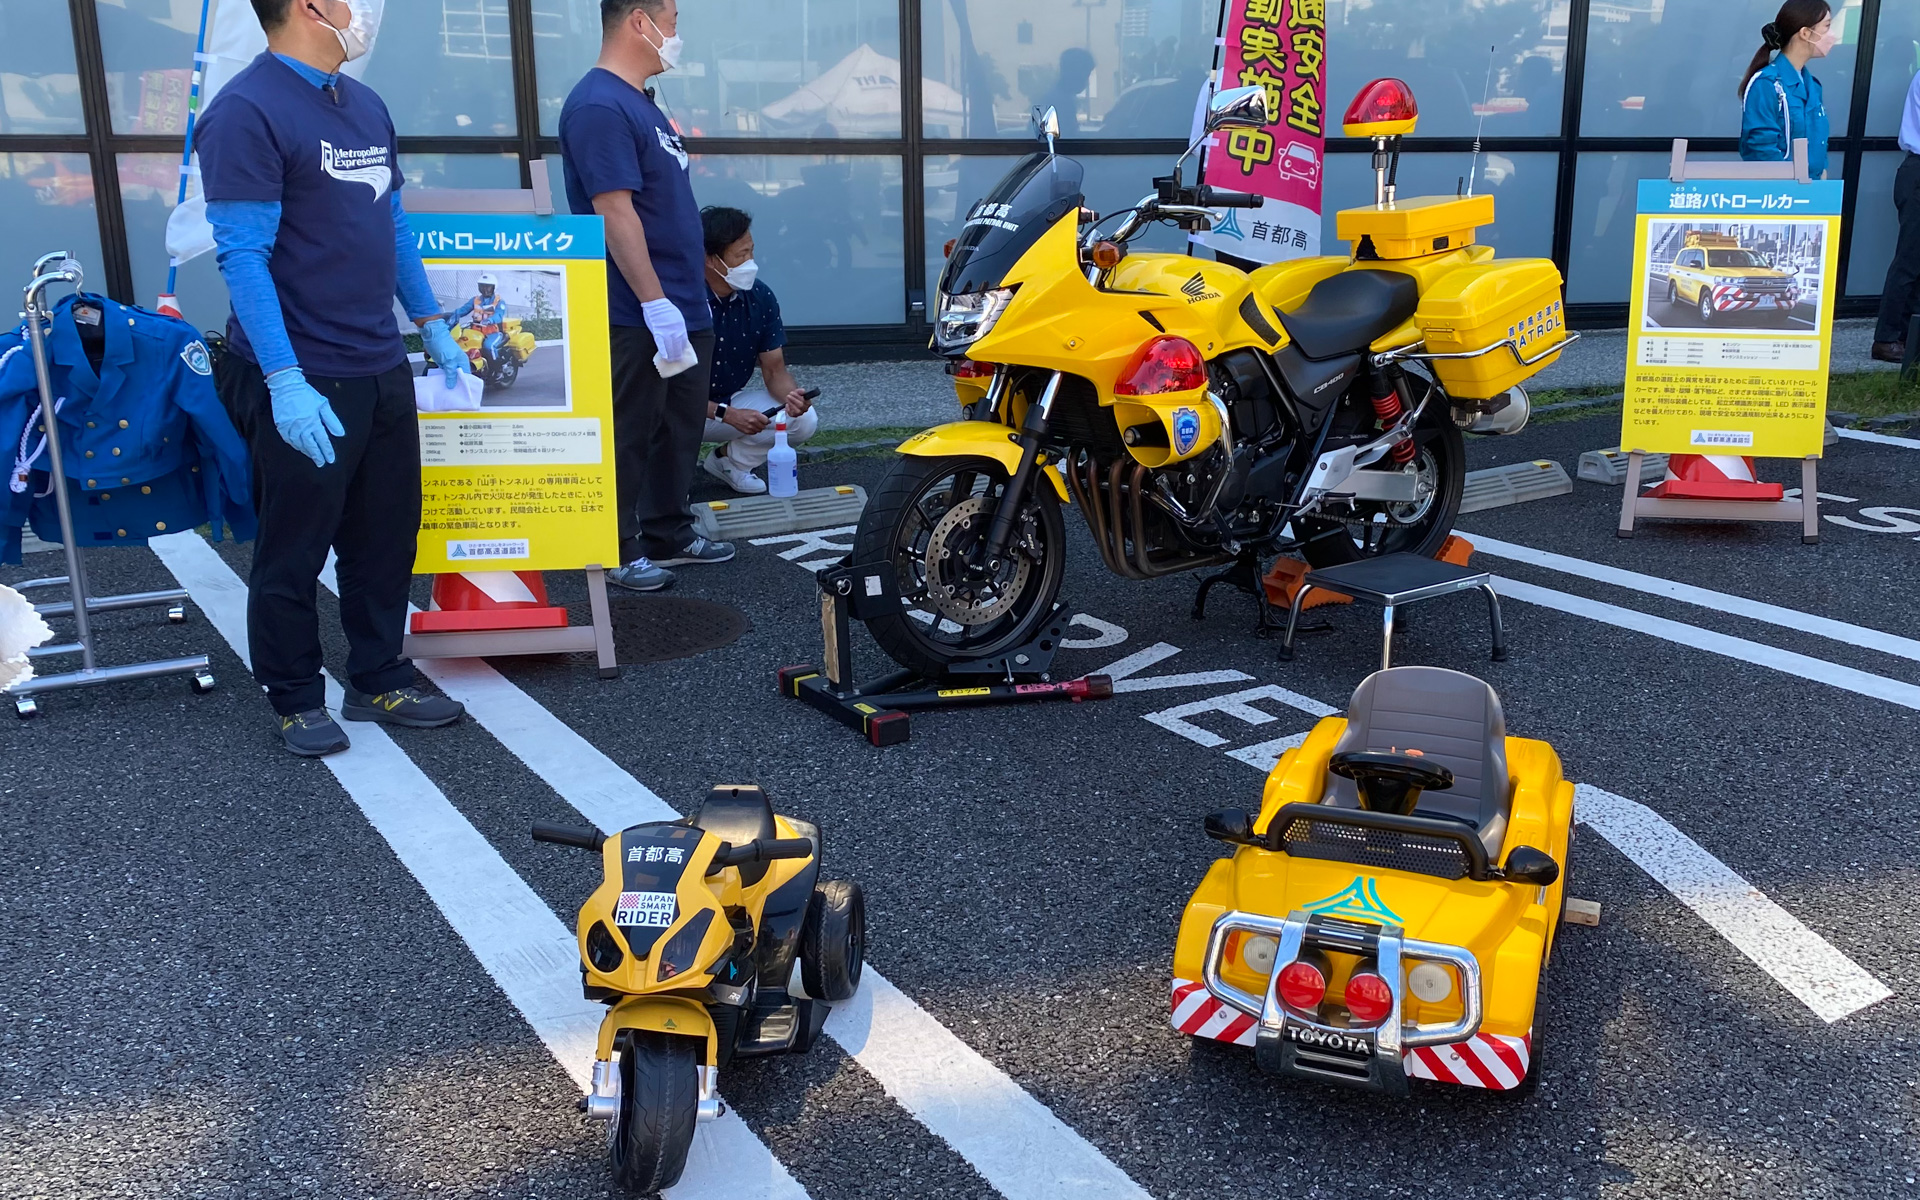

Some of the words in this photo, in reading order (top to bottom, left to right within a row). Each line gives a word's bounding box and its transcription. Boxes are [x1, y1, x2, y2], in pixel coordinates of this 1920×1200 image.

[334, 146, 388, 158] Metropolitan
[334, 156, 386, 168] Expressway
[1669, 193, 1810, 209] 道路パトロールカー
[412, 231, 574, 251] パトロールバイク
[1251, 220, 1308, 251] 首都高
[1186, 292, 1222, 304] HONDA
[1314, 372, 1344, 394] CB400
[419, 521, 521, 530] 輪車の緊急車両となります。
[627, 845, 685, 864] 首都高
[640, 902, 673, 910] SMART
[642, 895, 674, 903] JAPAN
[617, 910, 672, 925] RIDER
[1288, 1026, 1370, 1054] TOYOTA
